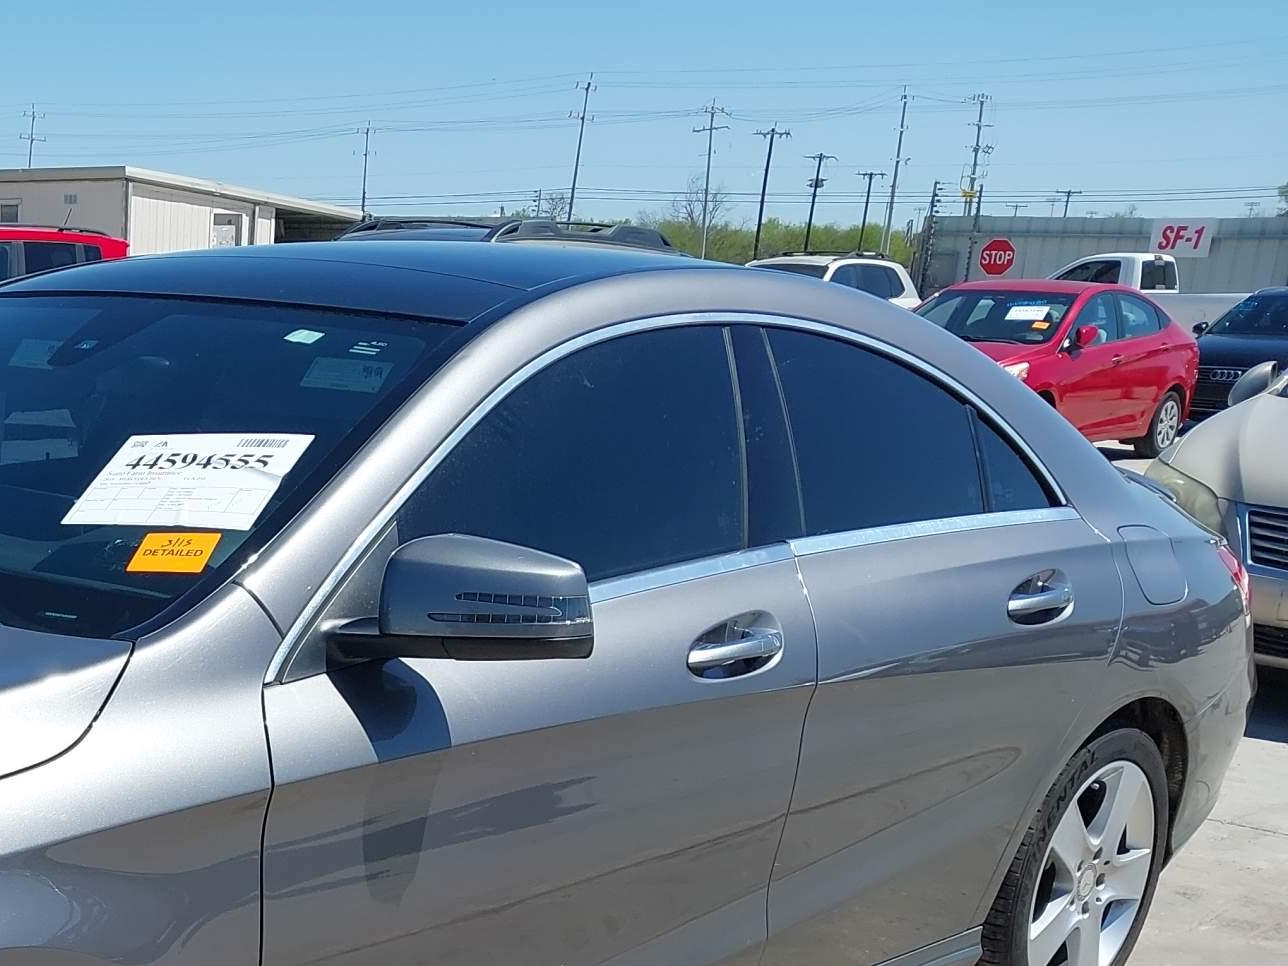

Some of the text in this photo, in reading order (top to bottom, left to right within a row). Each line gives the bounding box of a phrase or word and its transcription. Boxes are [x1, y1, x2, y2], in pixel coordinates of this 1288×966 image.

[1158, 225, 1206, 251] SF-1
[981, 250, 1013, 265] STOP
[125, 452, 276, 470] 44594555
[142, 548, 204, 557] DETAILED
